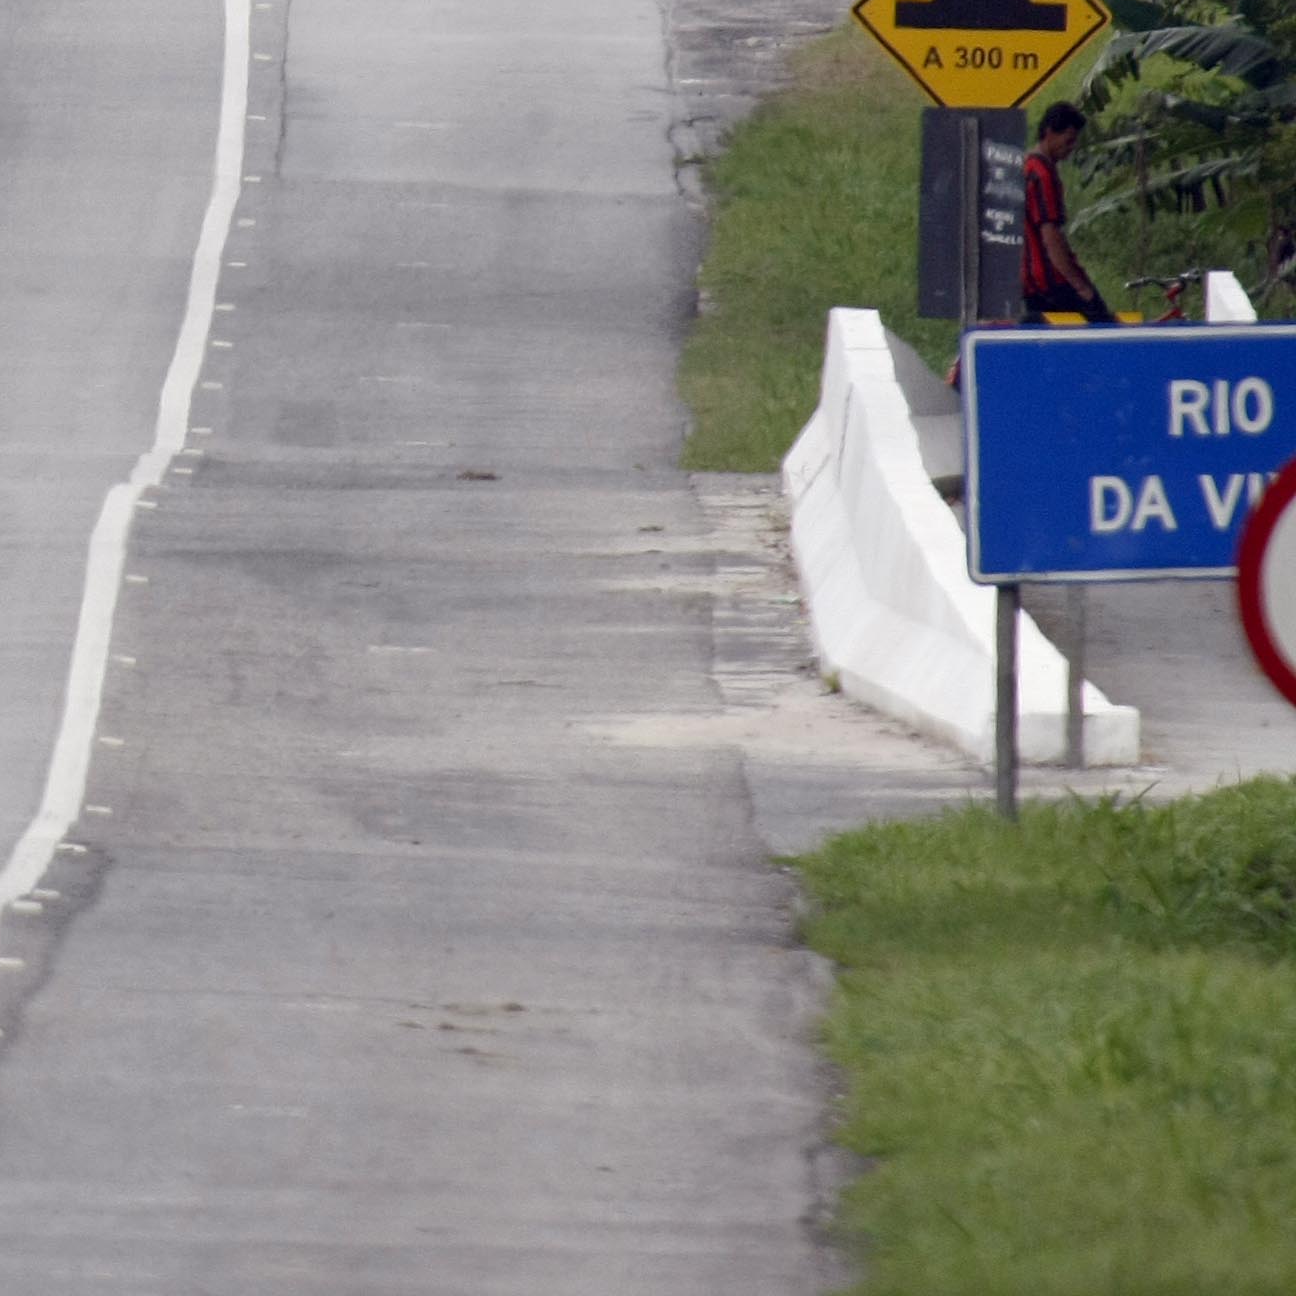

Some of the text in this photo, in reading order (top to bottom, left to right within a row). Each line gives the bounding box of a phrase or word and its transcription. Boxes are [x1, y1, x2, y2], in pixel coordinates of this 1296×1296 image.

[922, 45, 1040, 70] A 300 m
[1168, 375, 1275, 437] RIO
[1088, 470, 1281, 533] DA VI
